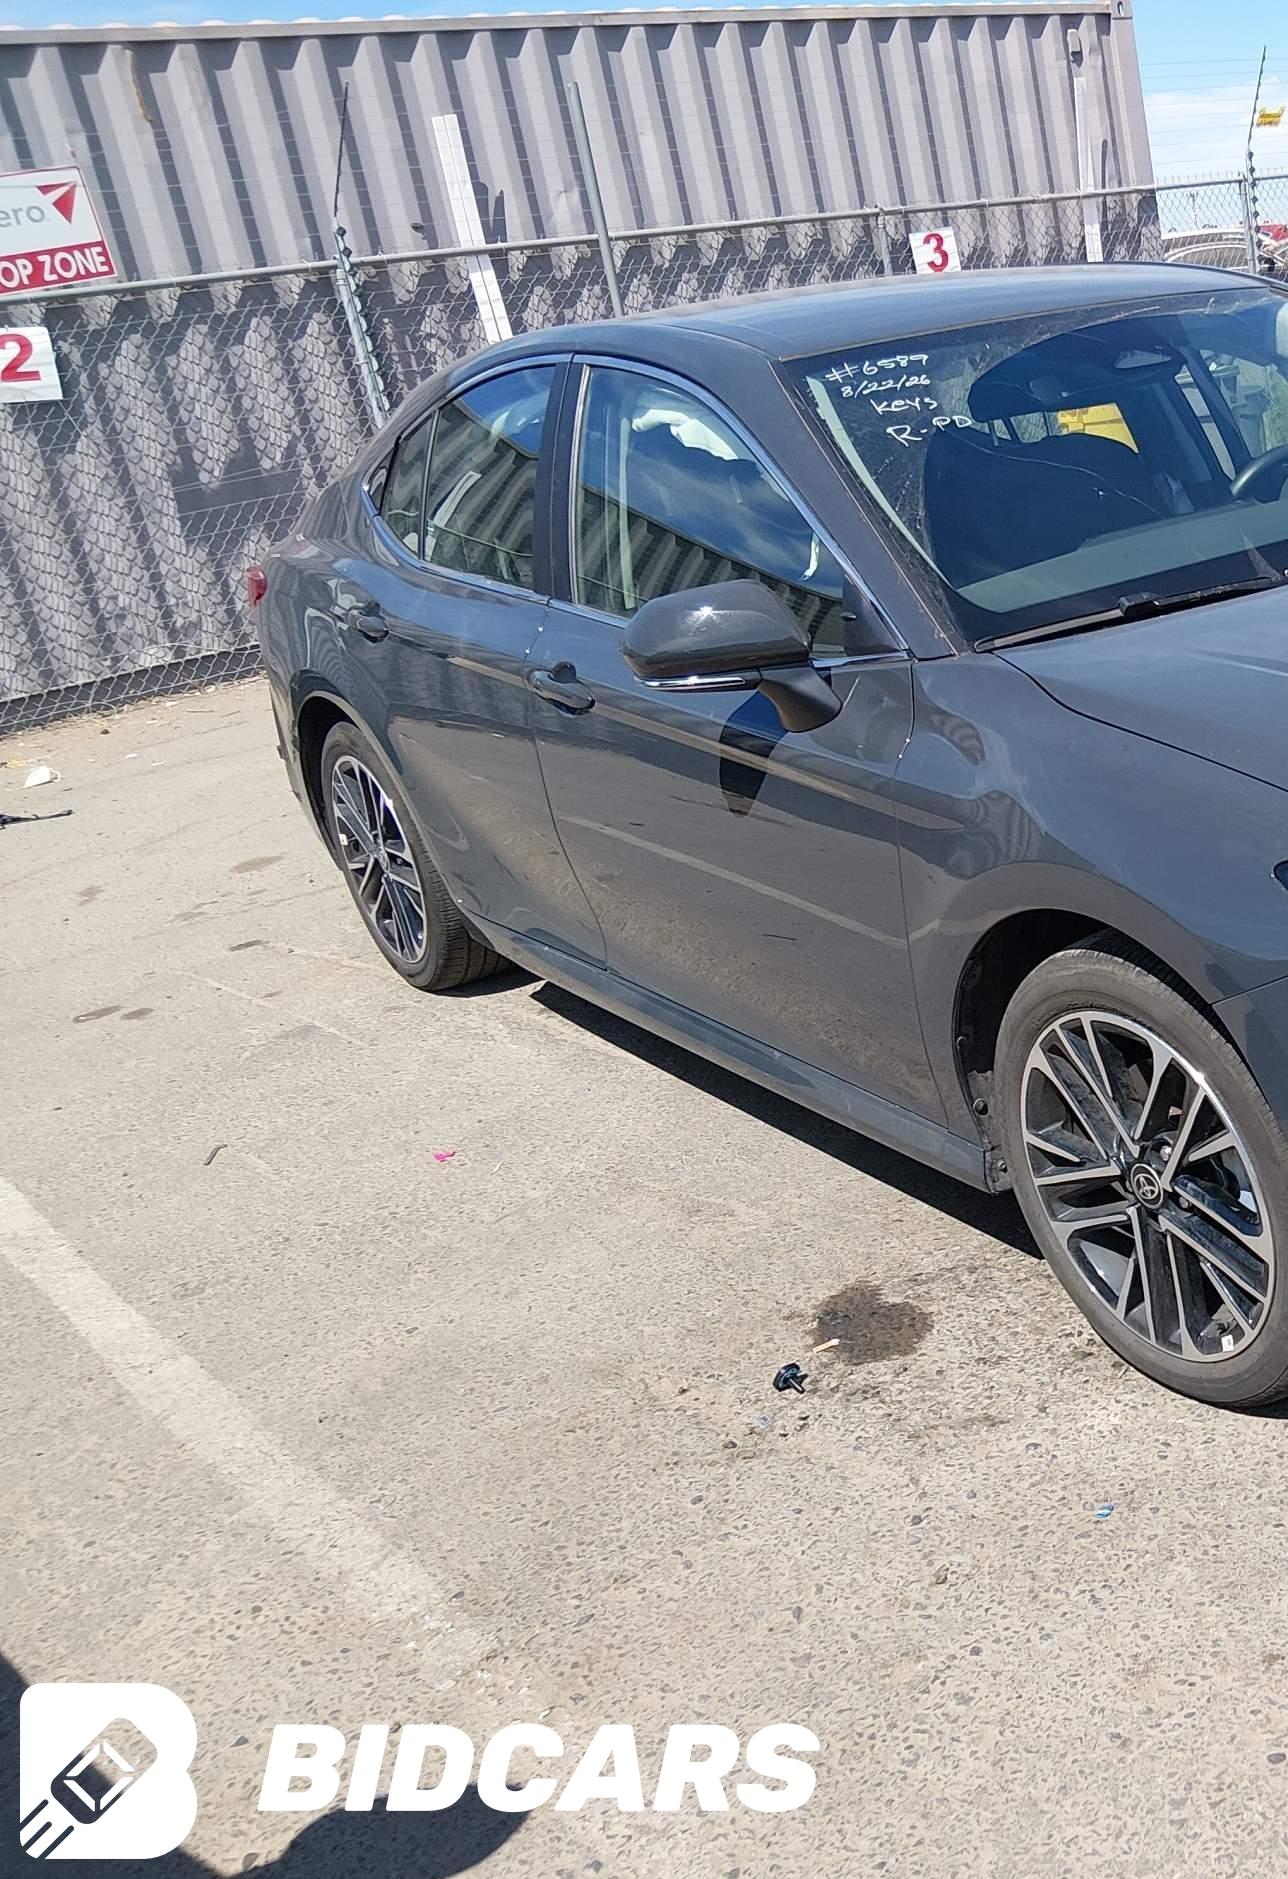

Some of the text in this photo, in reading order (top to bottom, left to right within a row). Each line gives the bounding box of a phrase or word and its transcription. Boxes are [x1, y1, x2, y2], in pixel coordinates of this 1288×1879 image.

[0, 246, 109, 289] OP ZONE
[922, 232, 949, 273] 3
[0, 333, 42, 383] 2
[841, 375, 931, 399] 8/22/26
